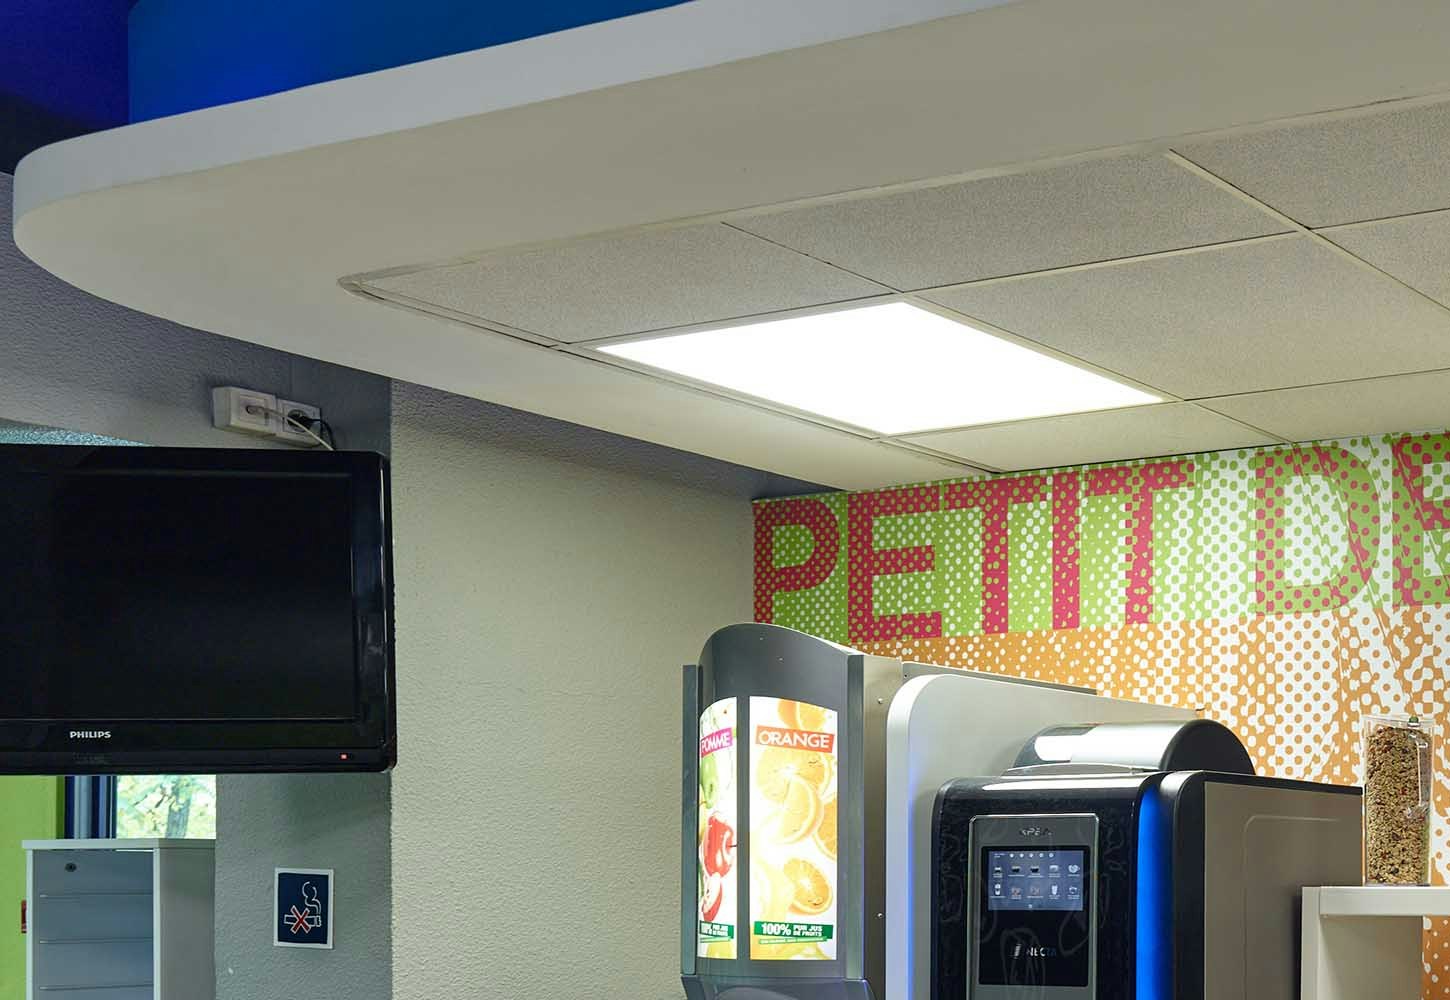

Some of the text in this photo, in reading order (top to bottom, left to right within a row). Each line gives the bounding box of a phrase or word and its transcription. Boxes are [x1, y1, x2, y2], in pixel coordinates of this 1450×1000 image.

[752, 460, 1195, 644] PETIT
[69, 730, 111, 739] PHILIPS
[701, 732, 731, 753] POMME
[758, 730, 830, 749] ORANGE
[761, 922, 792, 936] 100%
